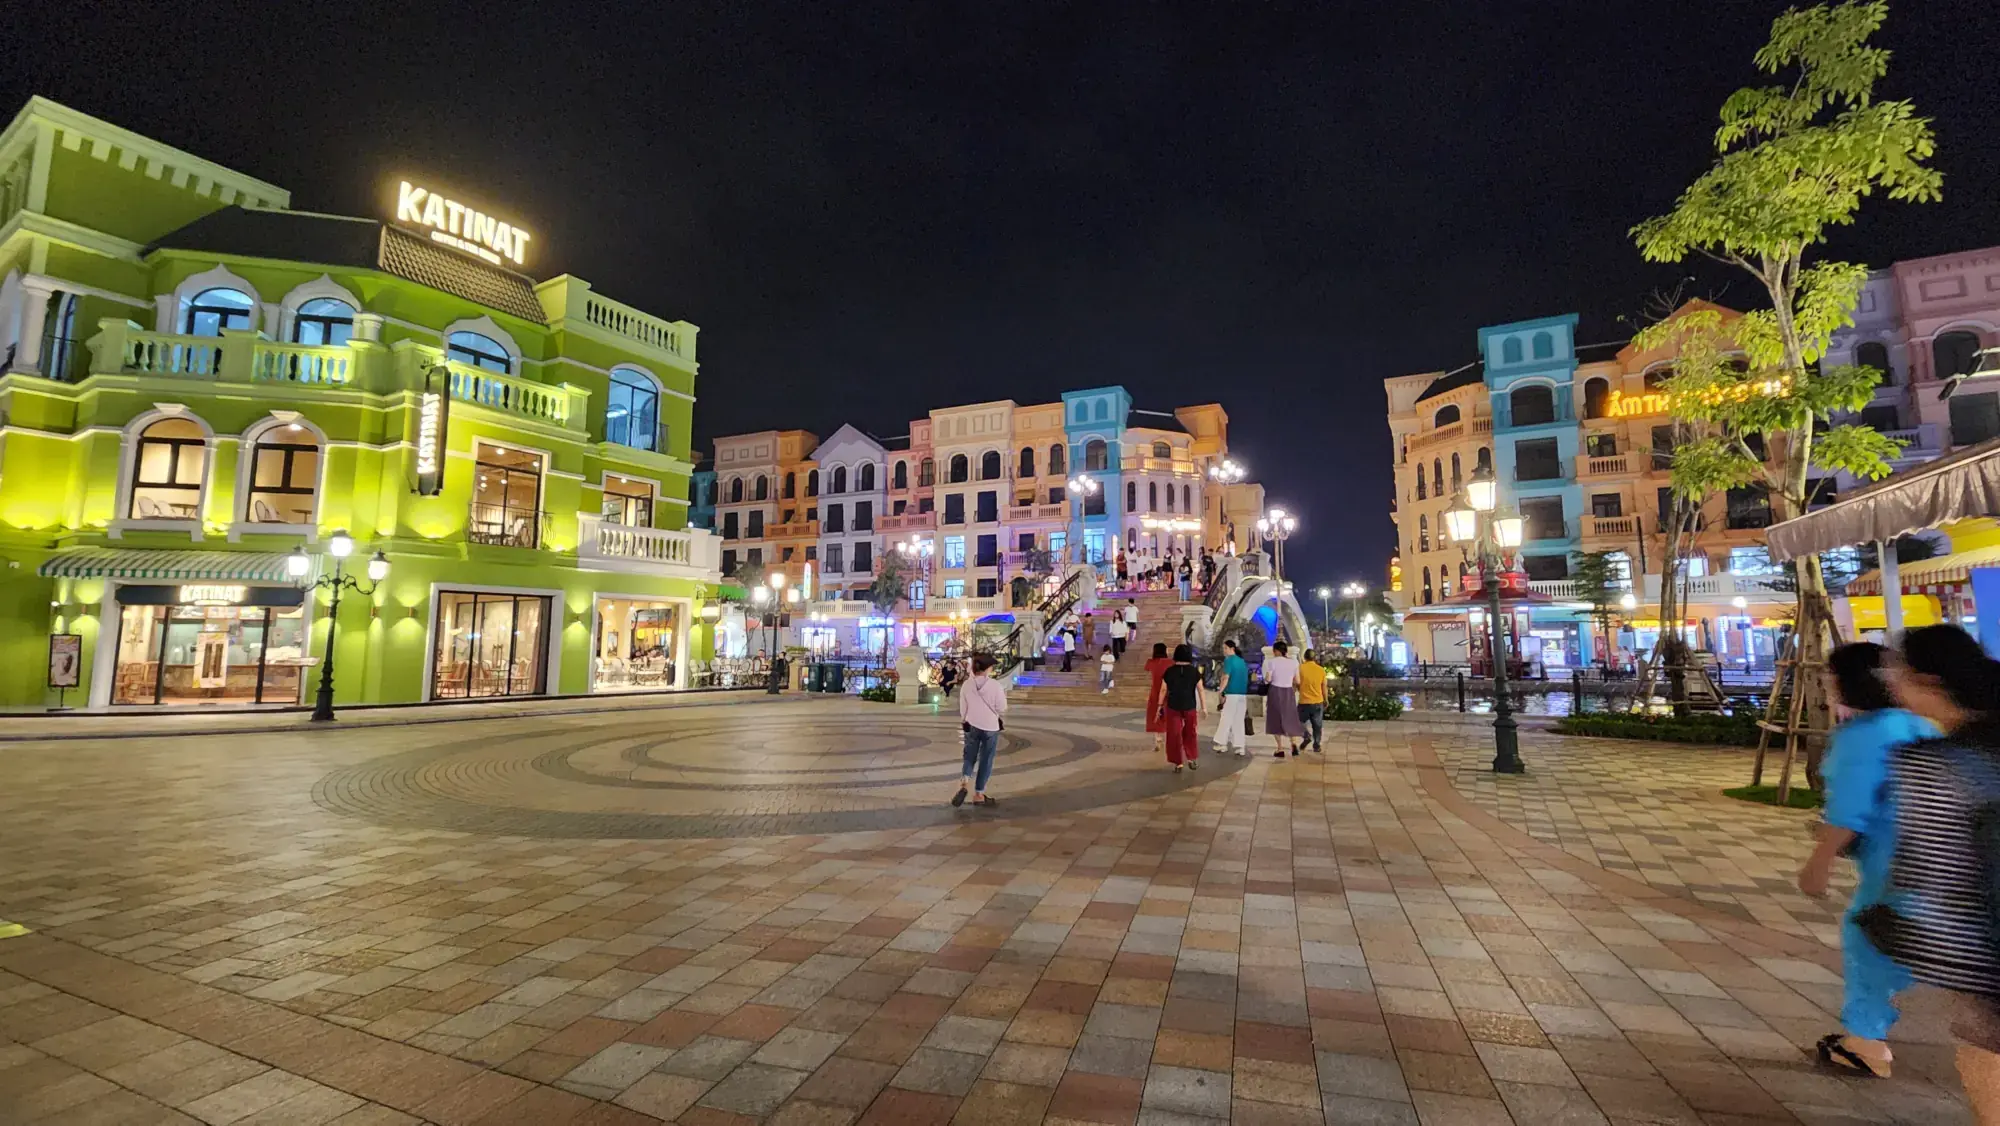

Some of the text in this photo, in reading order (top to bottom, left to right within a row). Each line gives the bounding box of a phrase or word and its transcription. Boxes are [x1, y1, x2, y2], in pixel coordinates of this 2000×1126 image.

[397, 181, 530, 264] KATINAT
[417, 393, 440, 474] KATINAT
[180, 585, 246, 602] KATINAT
